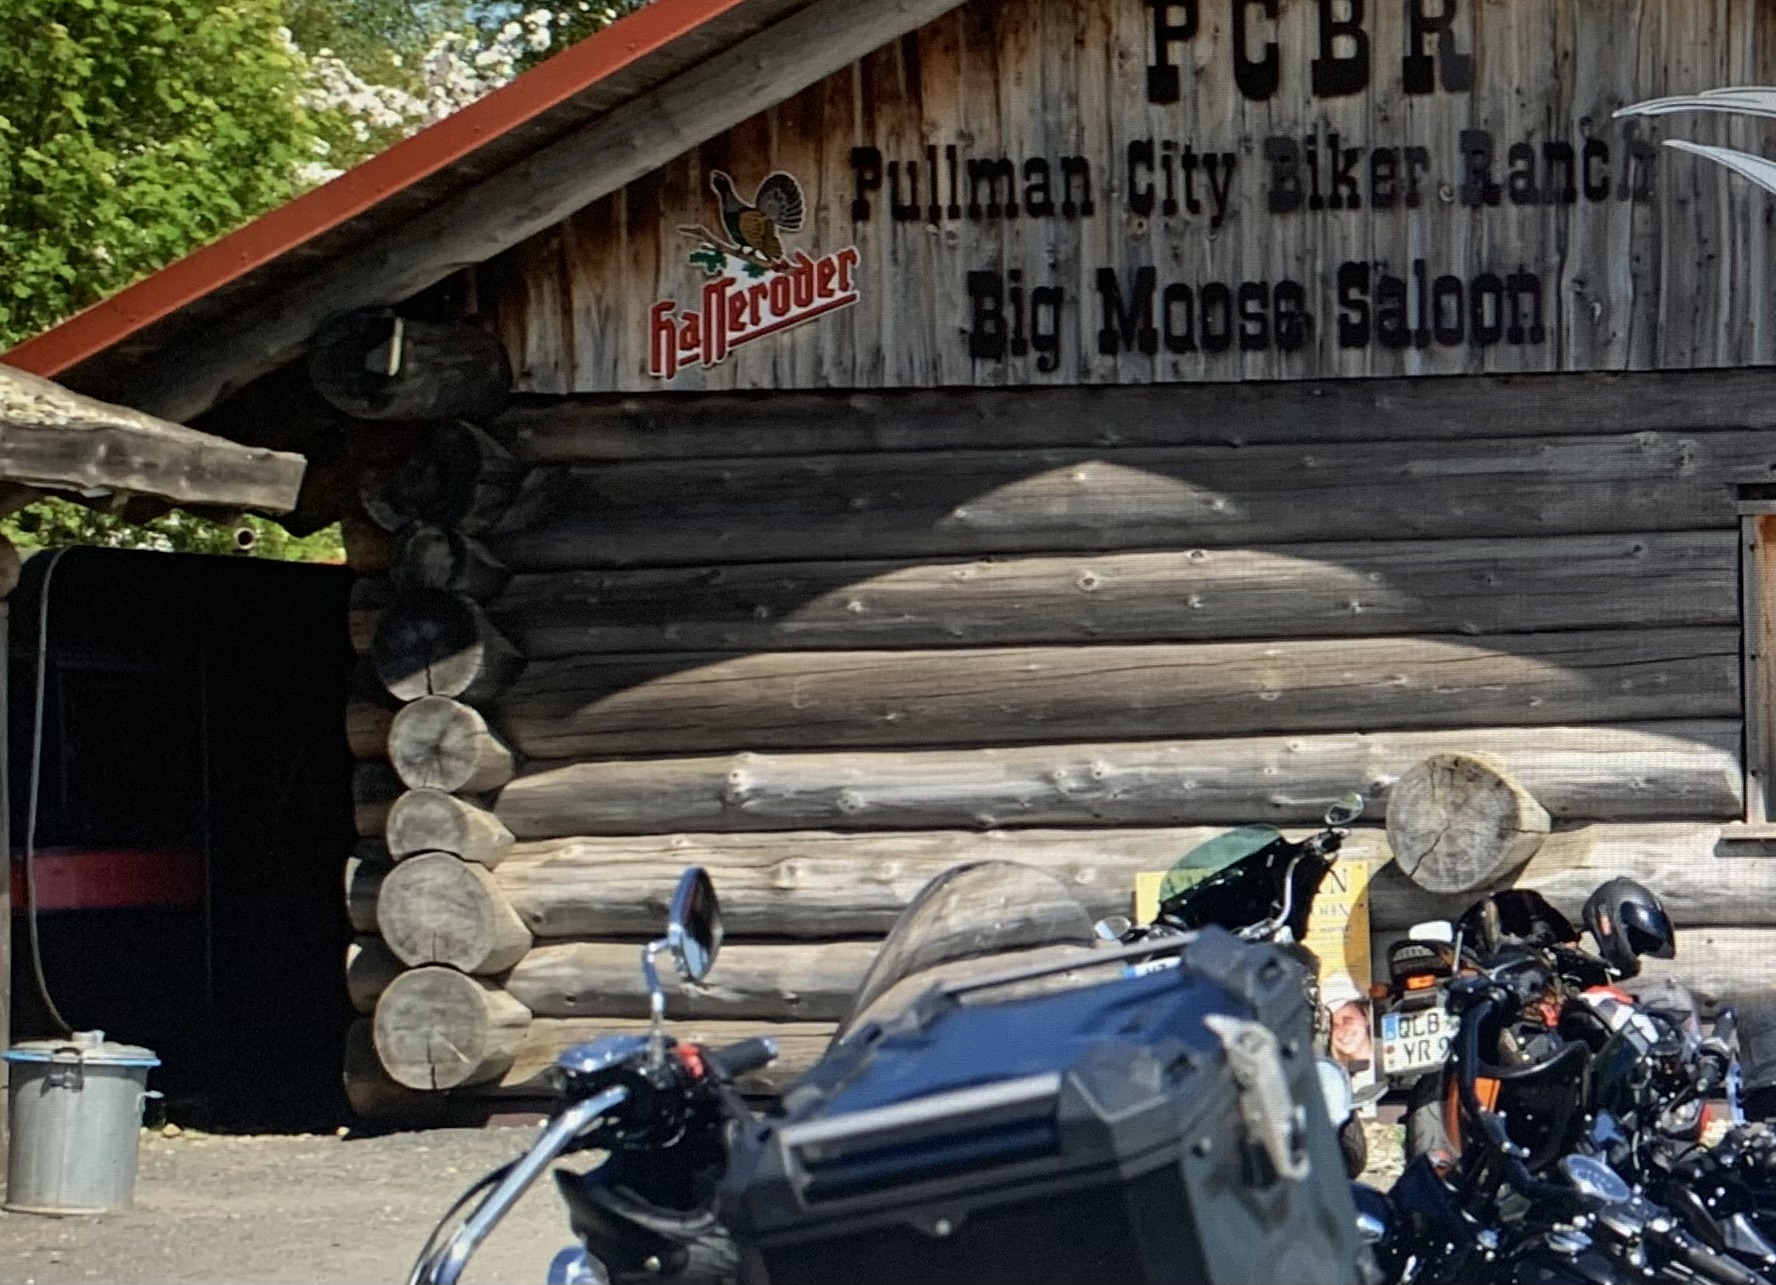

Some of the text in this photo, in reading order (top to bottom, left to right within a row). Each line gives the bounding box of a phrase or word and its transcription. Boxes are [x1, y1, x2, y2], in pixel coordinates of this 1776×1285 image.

[851, 120, 1655, 228] Pullman City Biker Ranch
[968, 258, 1545, 373] Big Moose Saloon
[1403, 1040, 1431, 1064] YR
